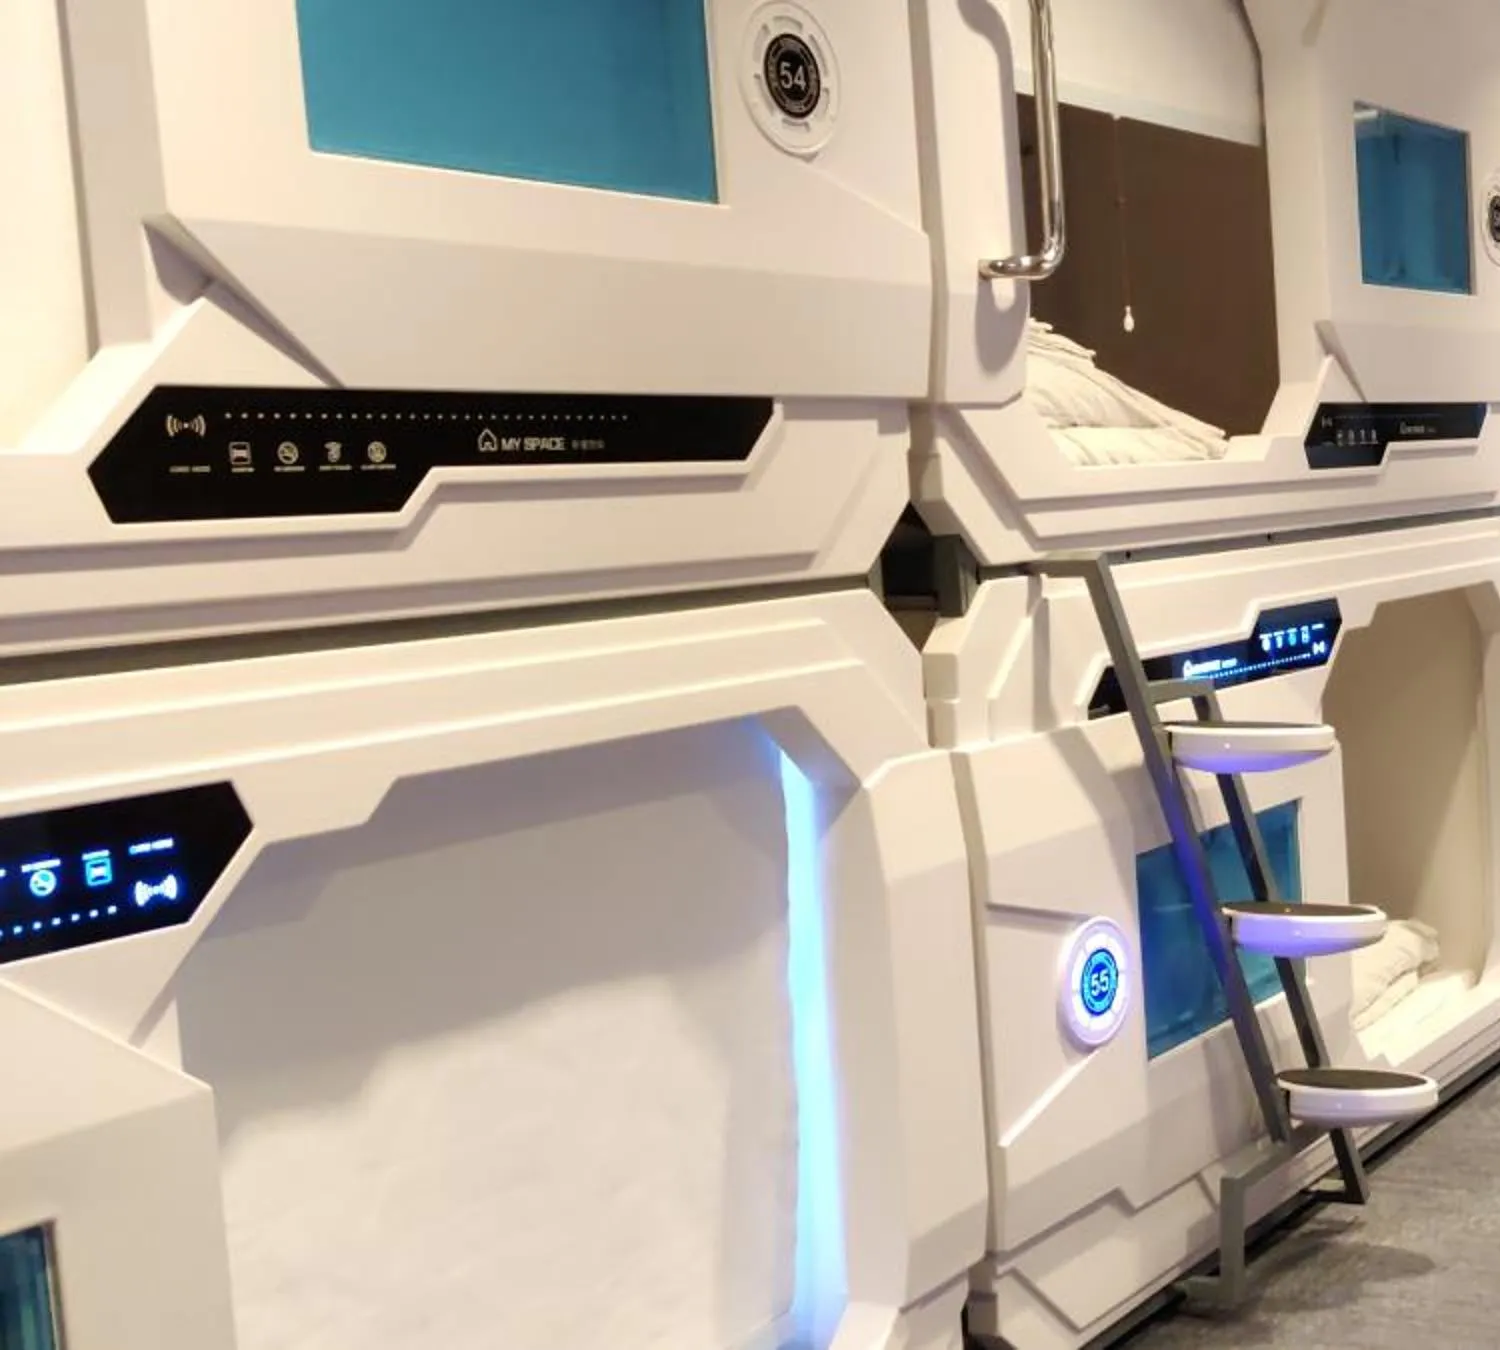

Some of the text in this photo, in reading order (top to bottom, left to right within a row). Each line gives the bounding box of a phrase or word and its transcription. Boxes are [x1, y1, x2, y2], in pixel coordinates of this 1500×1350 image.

[780, 61, 806, 91] 54
[501, 438, 520, 451] MY
[523, 437, 565, 451] SPACE
[1091, 969, 1109, 996] 55
